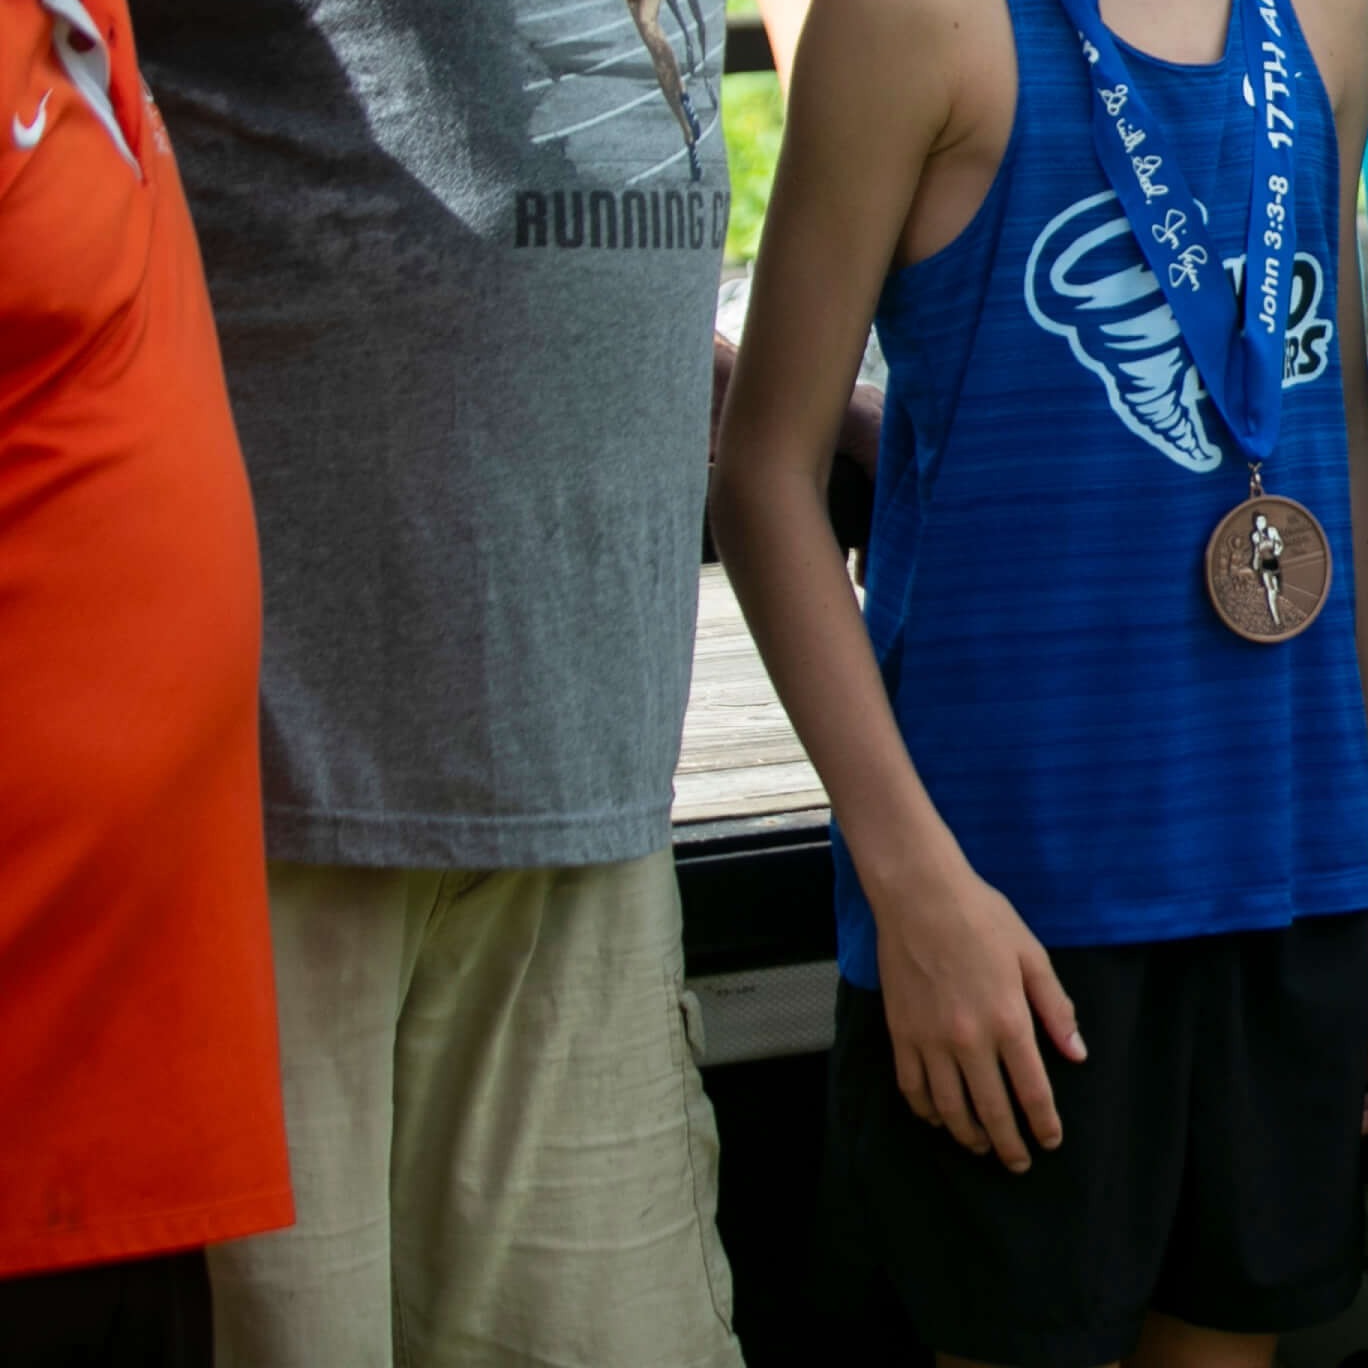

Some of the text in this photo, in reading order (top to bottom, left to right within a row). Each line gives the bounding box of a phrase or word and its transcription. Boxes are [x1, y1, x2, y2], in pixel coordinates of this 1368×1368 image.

[1262, 41, 1295, 150] 17TH
[513, 190, 704, 250] RUNNING
[1258, 174, 1290, 333] John 3:3-8
